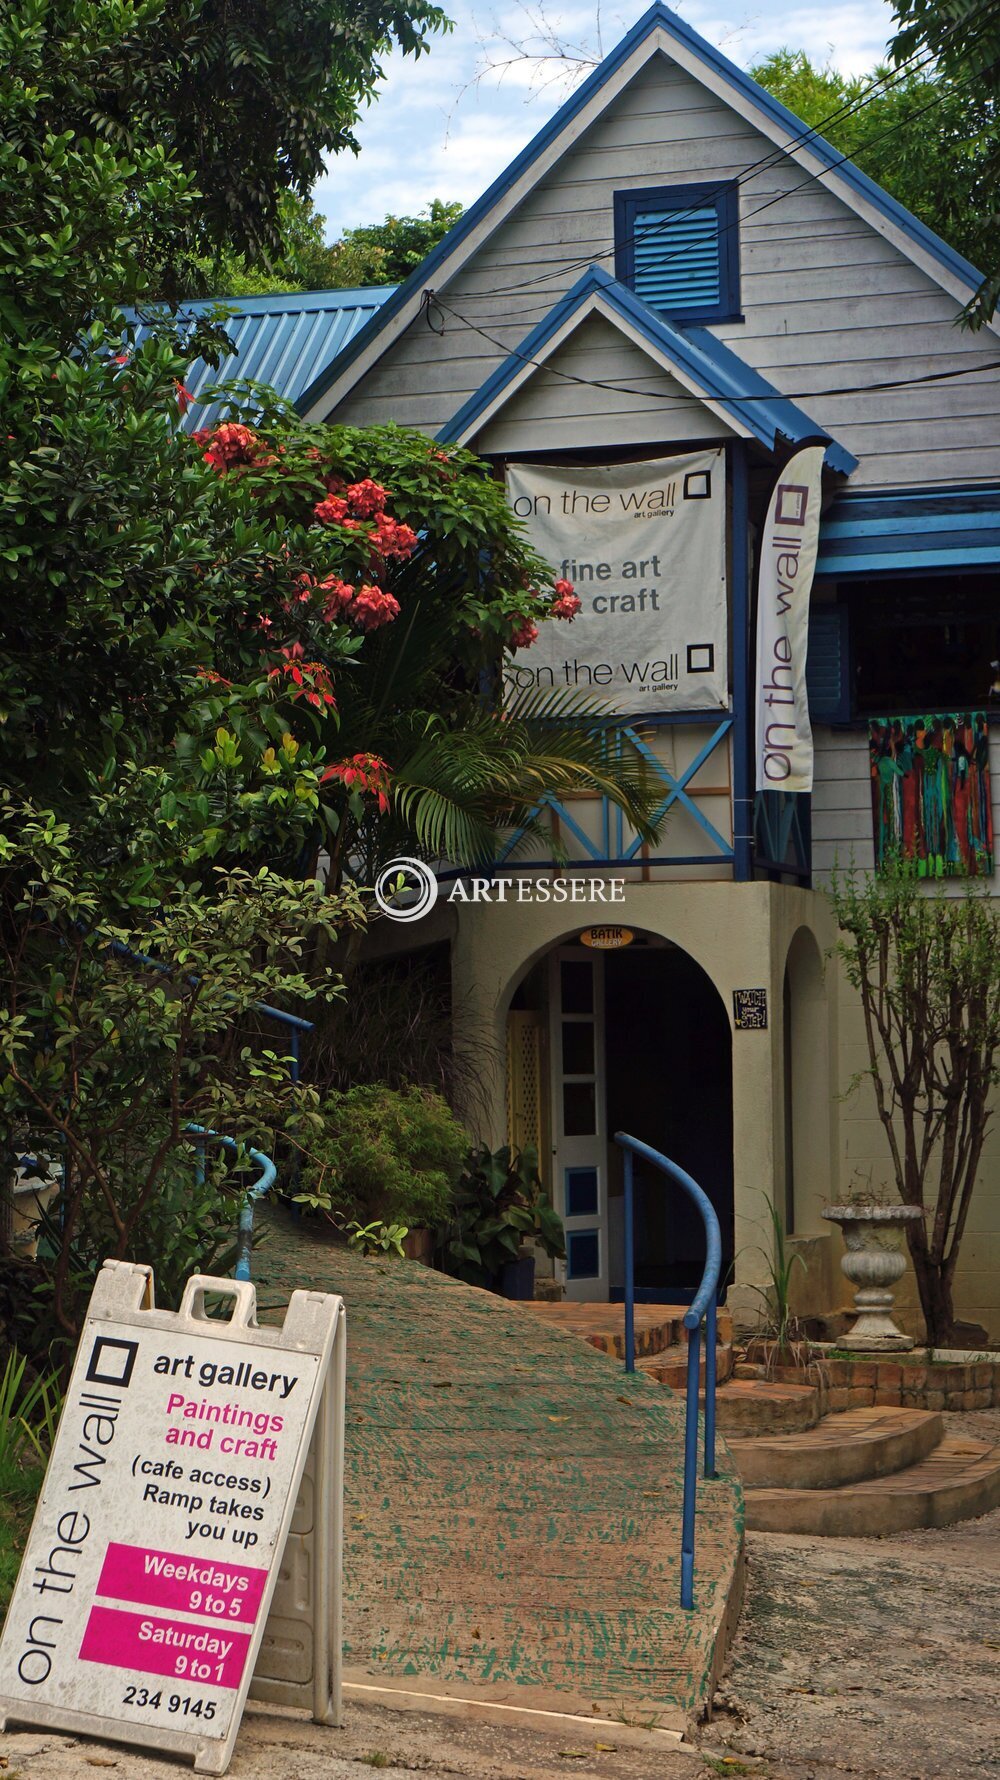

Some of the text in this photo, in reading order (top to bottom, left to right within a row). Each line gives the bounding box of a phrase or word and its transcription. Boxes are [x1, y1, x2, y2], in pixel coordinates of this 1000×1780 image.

[513, 482, 676, 517] on the wall
[633, 508, 675, 519] art gallery
[560, 555, 662, 582] fine art
[592, 588, 660, 614] craft
[515, 653, 678, 688] on the wall
[762, 536, 802, 782] on the wall
[638, 683, 678, 692] art gallery
[591, 928, 622, 939] BATIK
[738, 990, 767, 1006] WATCH
[741, 1007, 760, 1015] your
[741, 1010, 765, 1028] STEP!
[153, 1355, 298, 1399] art gallery
[166, 1393, 284, 1435] Paintings
[165, 1427, 278, 1460] and craft
[131, 1454, 271, 1499] (cafe access)
[142, 1483, 264, 1521] Ramp takes
[18, 1392, 122, 1685] on the wall
[185, 1521, 258, 1549] you up
[144, 1554, 249, 1593] Weekdays
[188, 1590, 243, 1617] 9 to 5
[138, 1621, 233, 1660] Saturday
[174, 1655, 225, 1682] 9 to 1
[122, 1686, 217, 1720] 234 9145
